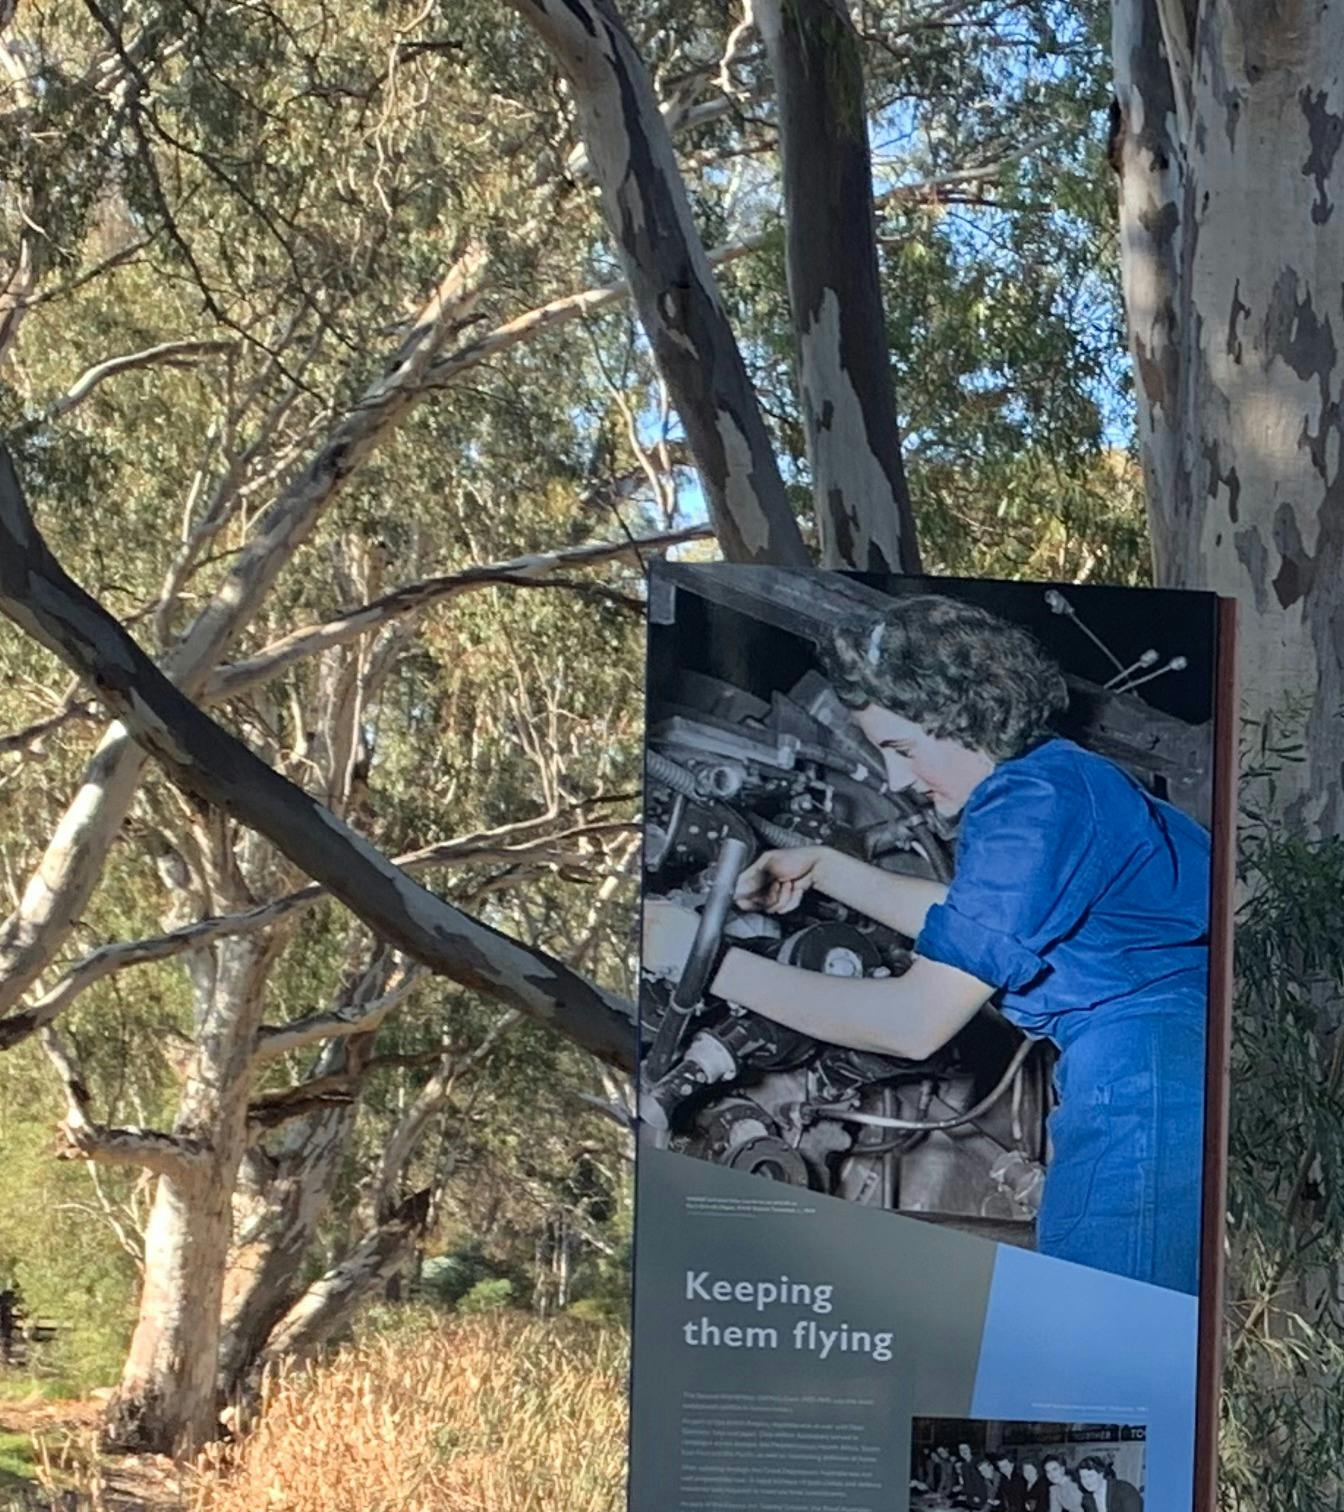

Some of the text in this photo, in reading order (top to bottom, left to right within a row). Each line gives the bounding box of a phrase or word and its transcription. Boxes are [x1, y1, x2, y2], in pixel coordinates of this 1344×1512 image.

[685, 1271, 834, 1313] Keeping
[683, 1317, 894, 1362] them flying
